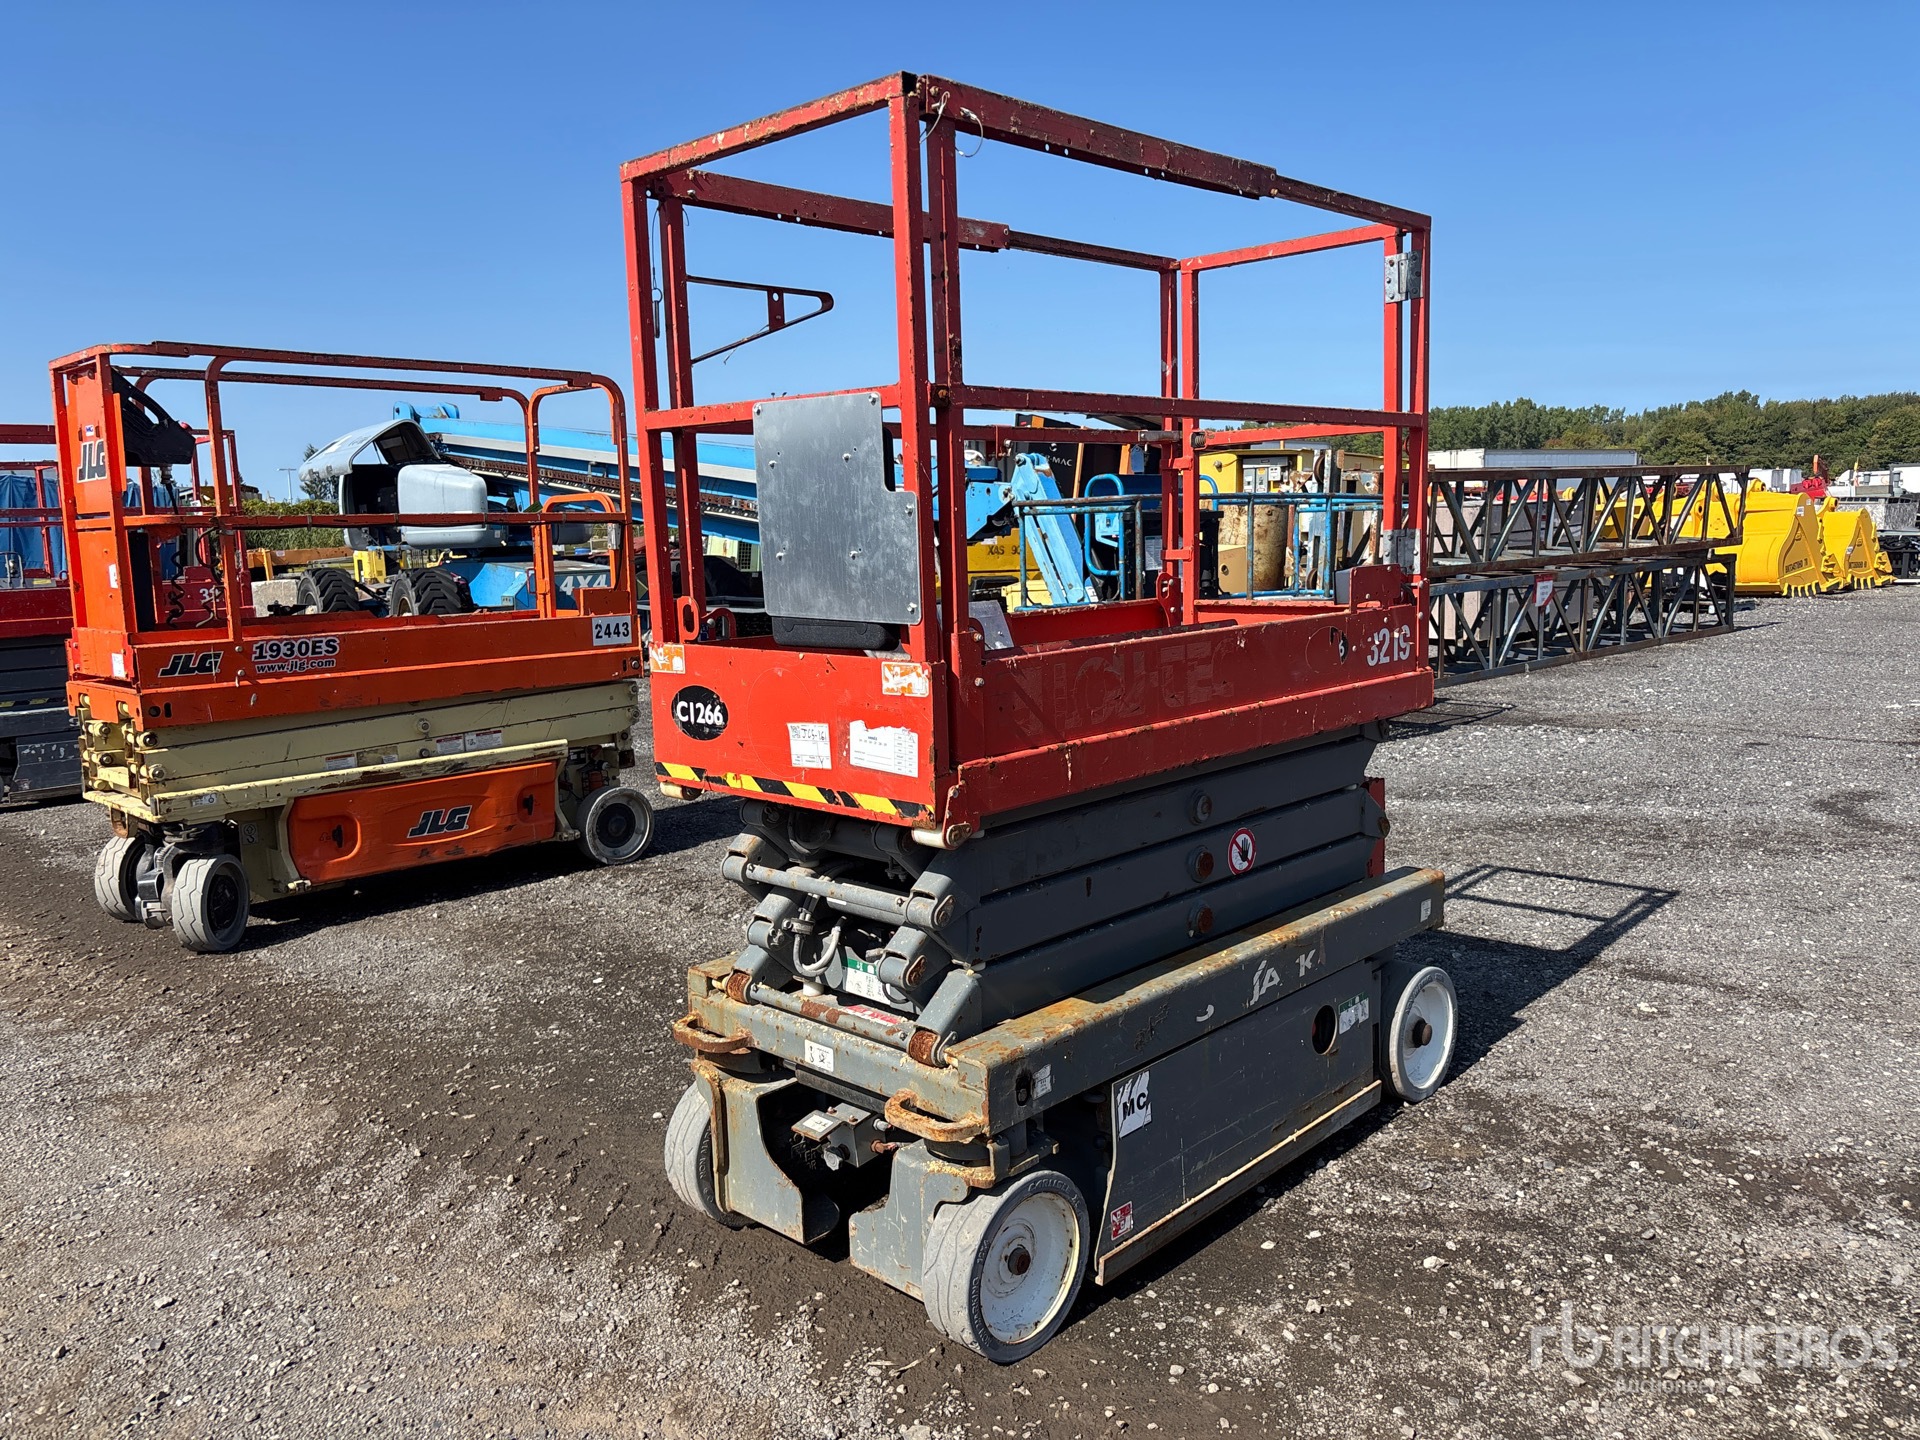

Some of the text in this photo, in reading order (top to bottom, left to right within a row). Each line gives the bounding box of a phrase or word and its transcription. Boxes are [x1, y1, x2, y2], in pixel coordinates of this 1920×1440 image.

[77, 439, 107, 483] JLG
[988, 545, 1005, 555] XAS
[559, 574, 607, 596] 4X4
[594, 621, 629, 639] 2443
[252, 637, 340, 662] 1930ES
[158, 651, 224, 678] JLG
[256, 658, 337, 674] www.jlg.com
[676, 700, 724, 726] C1266
[407, 805, 472, 838] JLG
